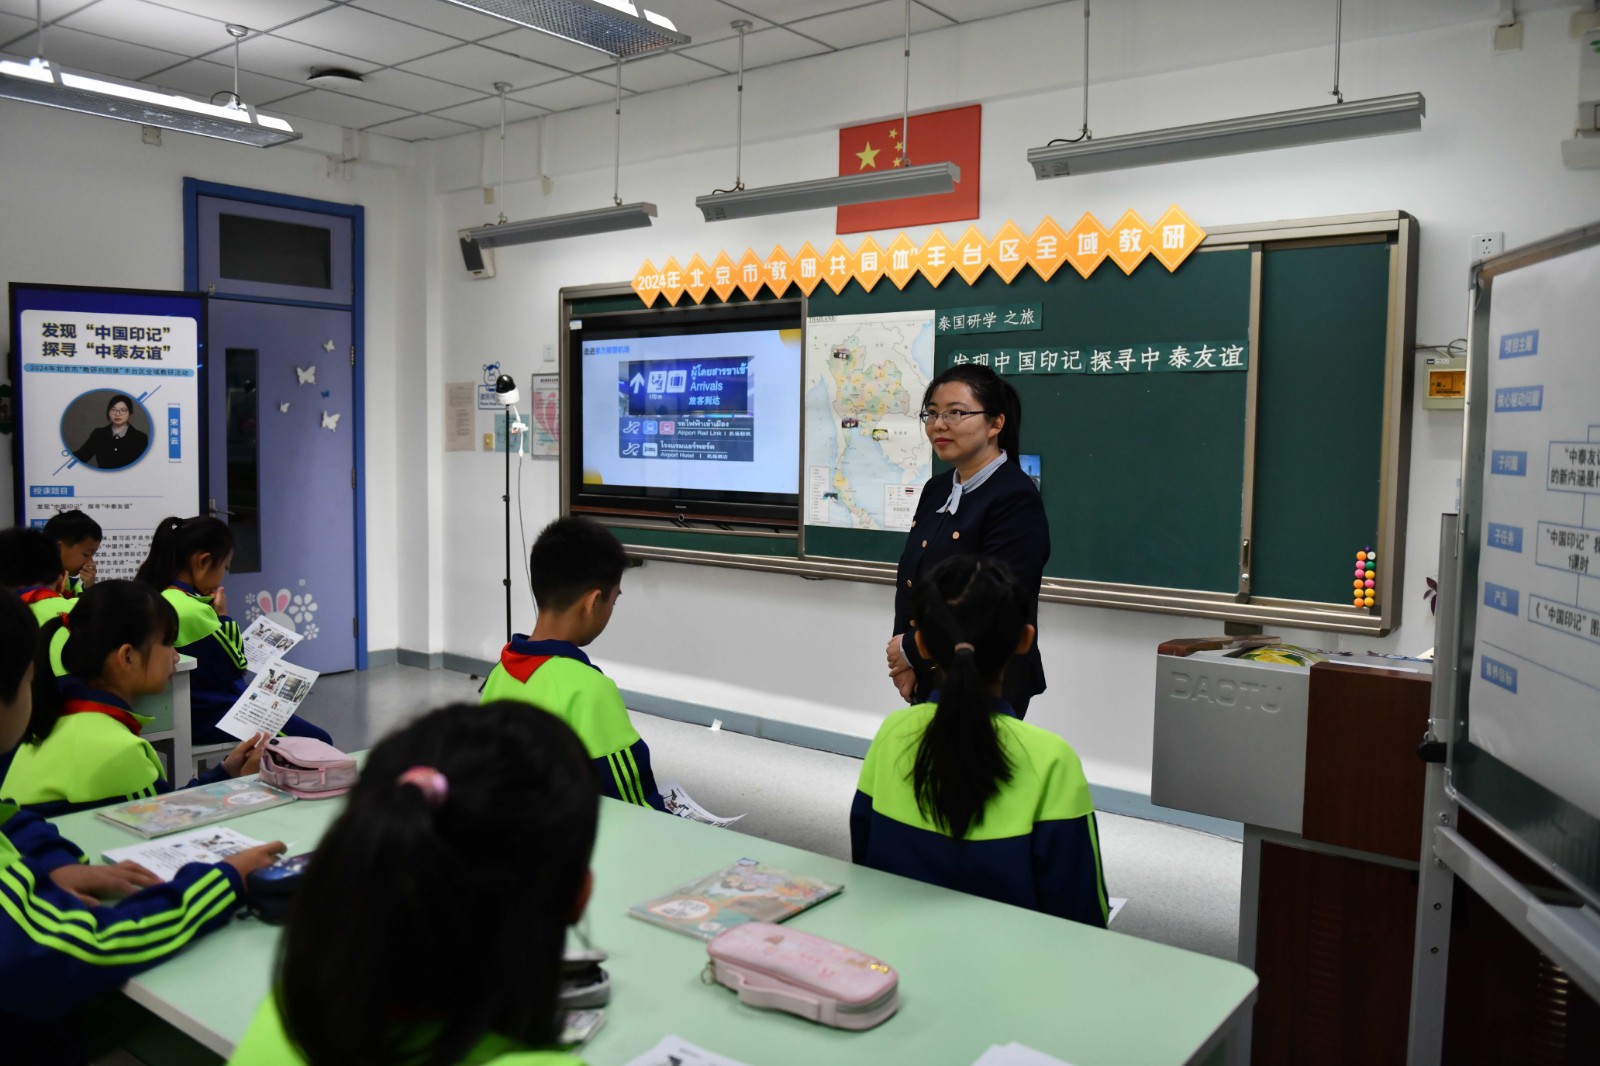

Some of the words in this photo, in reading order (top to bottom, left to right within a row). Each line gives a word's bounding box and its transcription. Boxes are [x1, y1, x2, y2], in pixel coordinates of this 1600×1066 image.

[690, 381, 723, 392] Arrivals
[688, 396, 721, 406] 旅客到达
[678, 430, 696, 438] Airport
[661, 452, 678, 460] Airport
[33, 487, 69, 495] 授课题目
